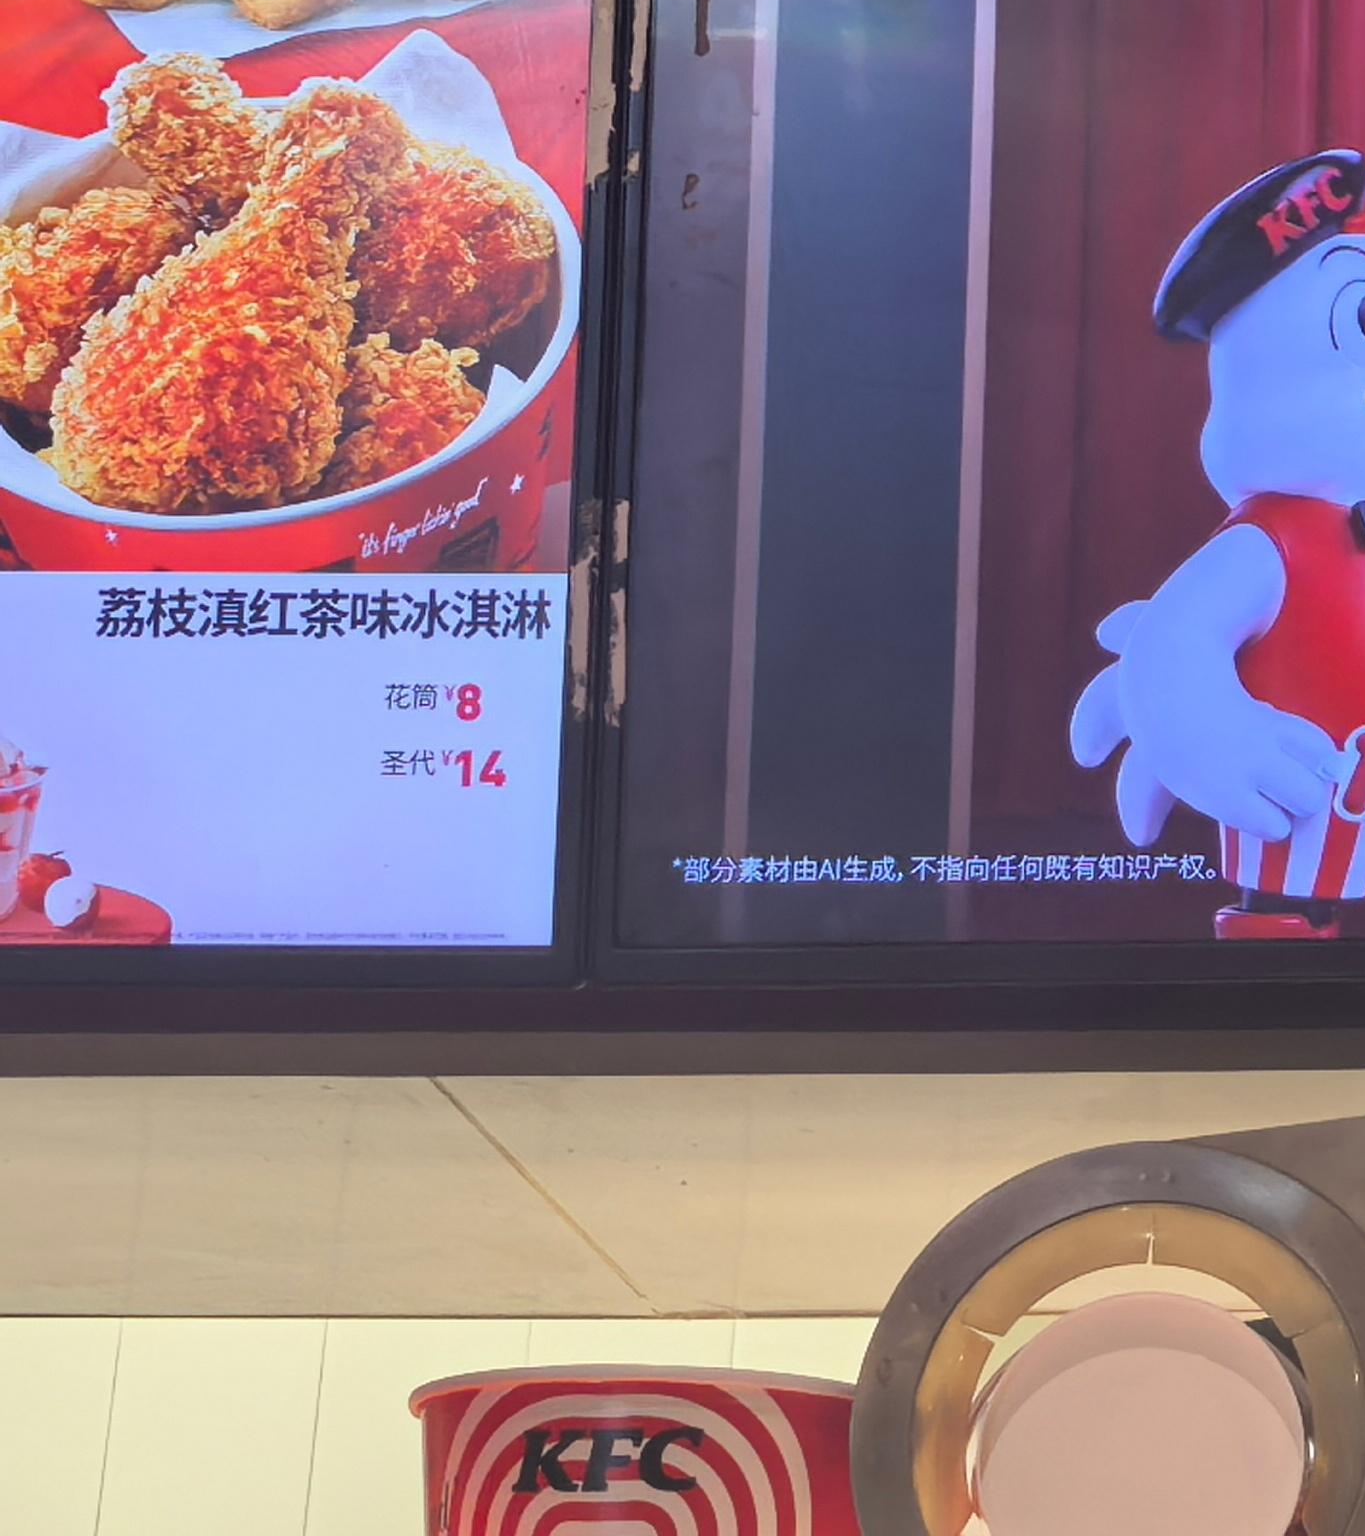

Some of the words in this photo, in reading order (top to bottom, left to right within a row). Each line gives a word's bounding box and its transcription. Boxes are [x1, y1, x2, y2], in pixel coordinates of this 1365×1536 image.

[1256, 167, 1353, 256] KFC
[96, 586, 553, 641] 荔枝滇红茶味冰淇淋
[384, 683, 439, 712] 花筒
[381, 750, 436, 777] 圣代
[511, 1424, 705, 1495] KFC
